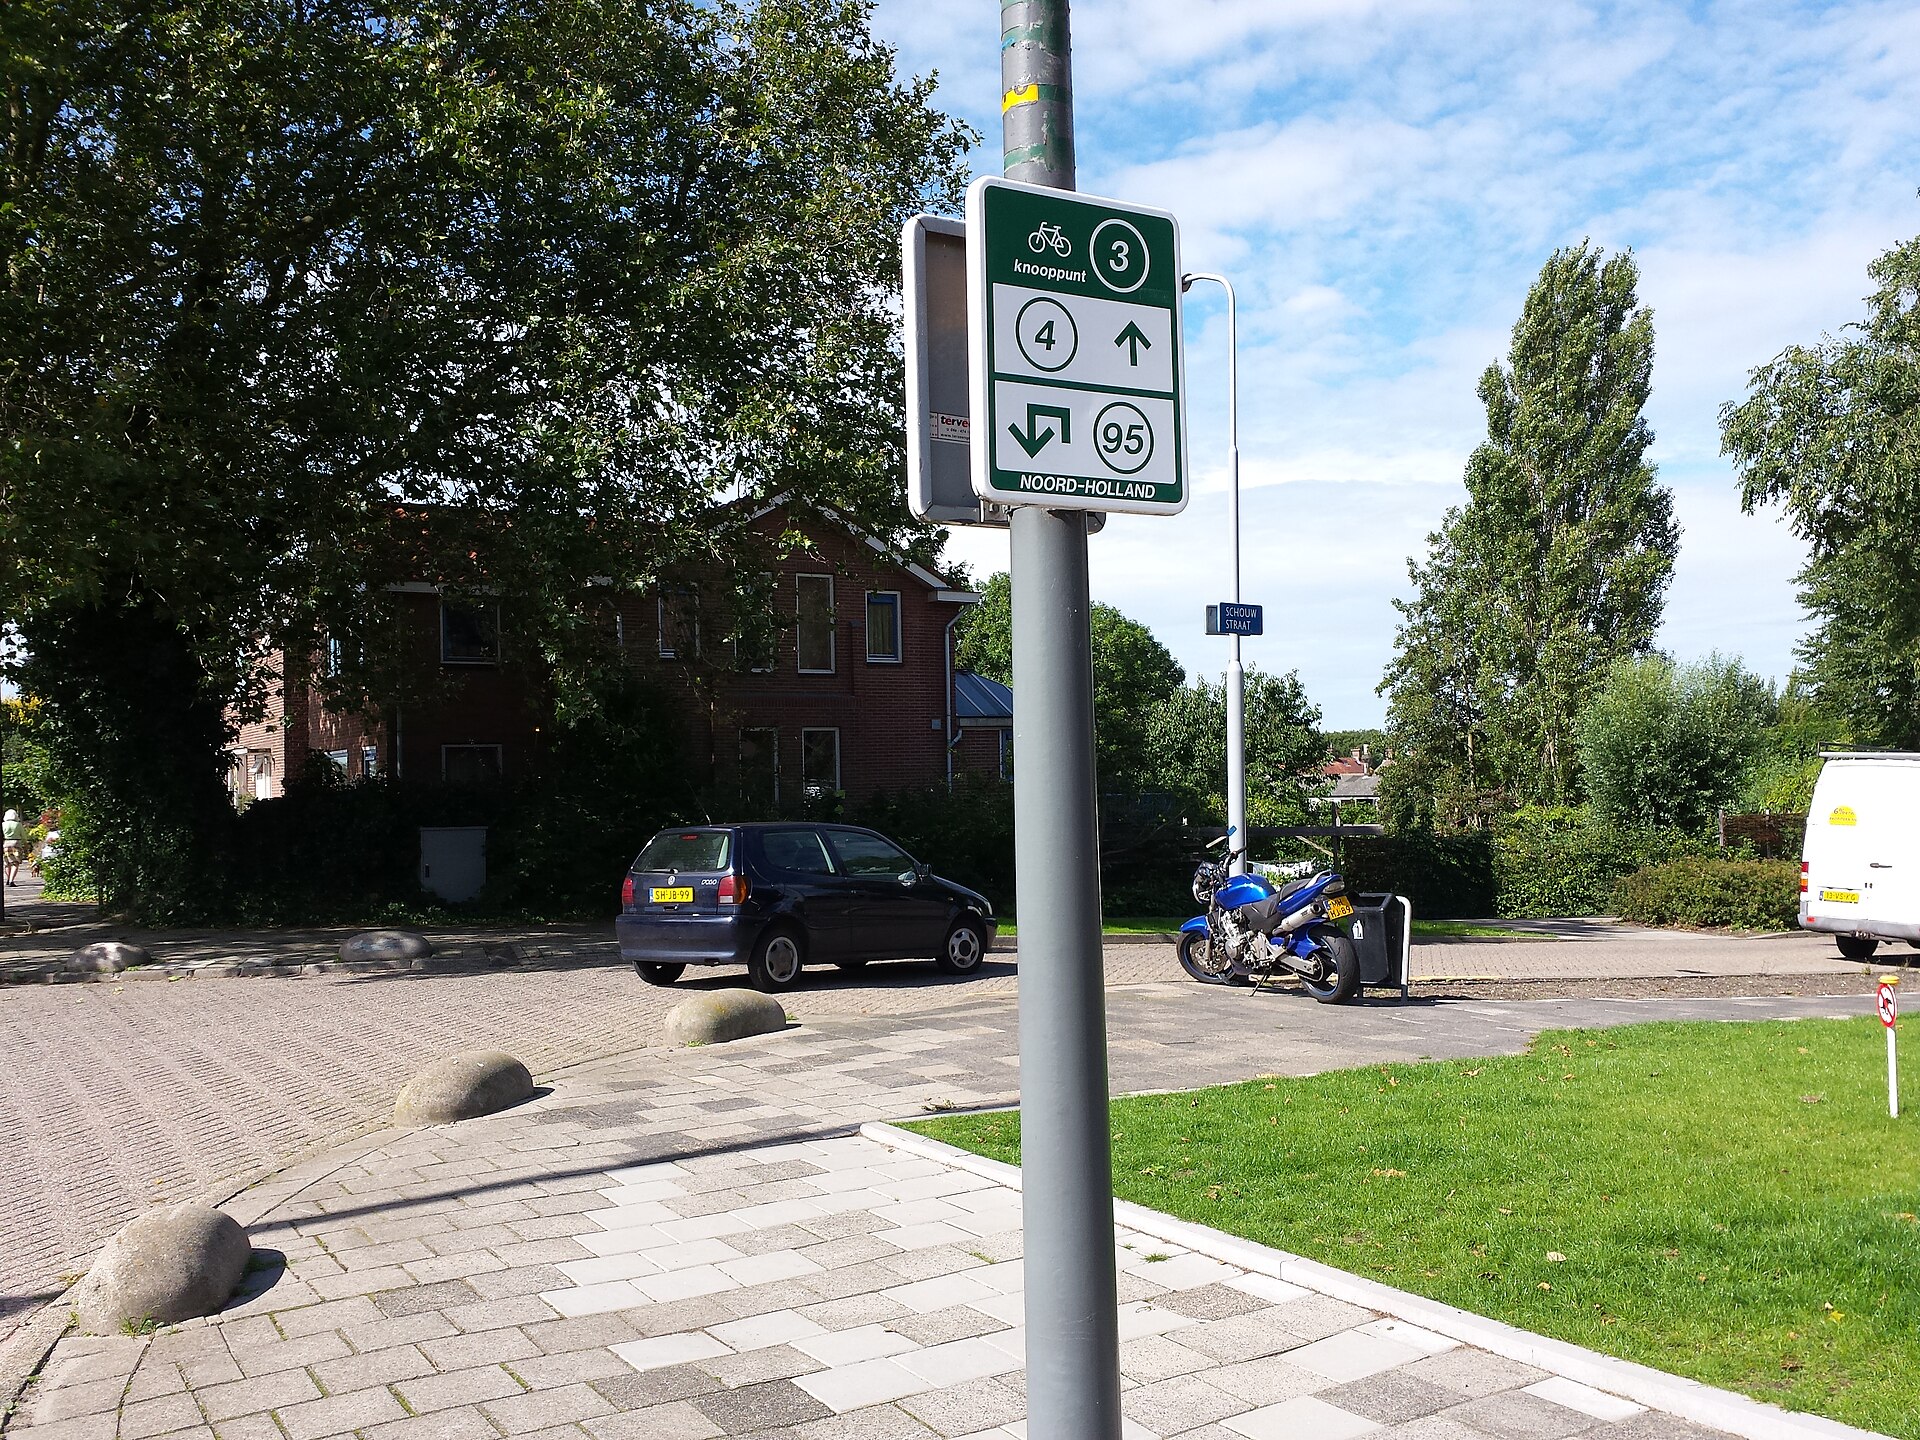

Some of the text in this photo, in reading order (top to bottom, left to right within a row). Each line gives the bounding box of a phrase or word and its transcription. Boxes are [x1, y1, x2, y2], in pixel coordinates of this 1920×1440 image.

[1108, 240, 1130, 272] 3
[1013, 258, 1087, 283] knooppunt
[1034, 319, 1056, 351] 4
[1102, 422, 1145, 455] 95
[1020, 474, 1156, 499] NOORD-HOLLAND
[1225, 606, 1258, 618] SCHOUW
[1225, 619, 1251, 631] STRAAT
[655, 890, 690, 900] SH-JB-99
